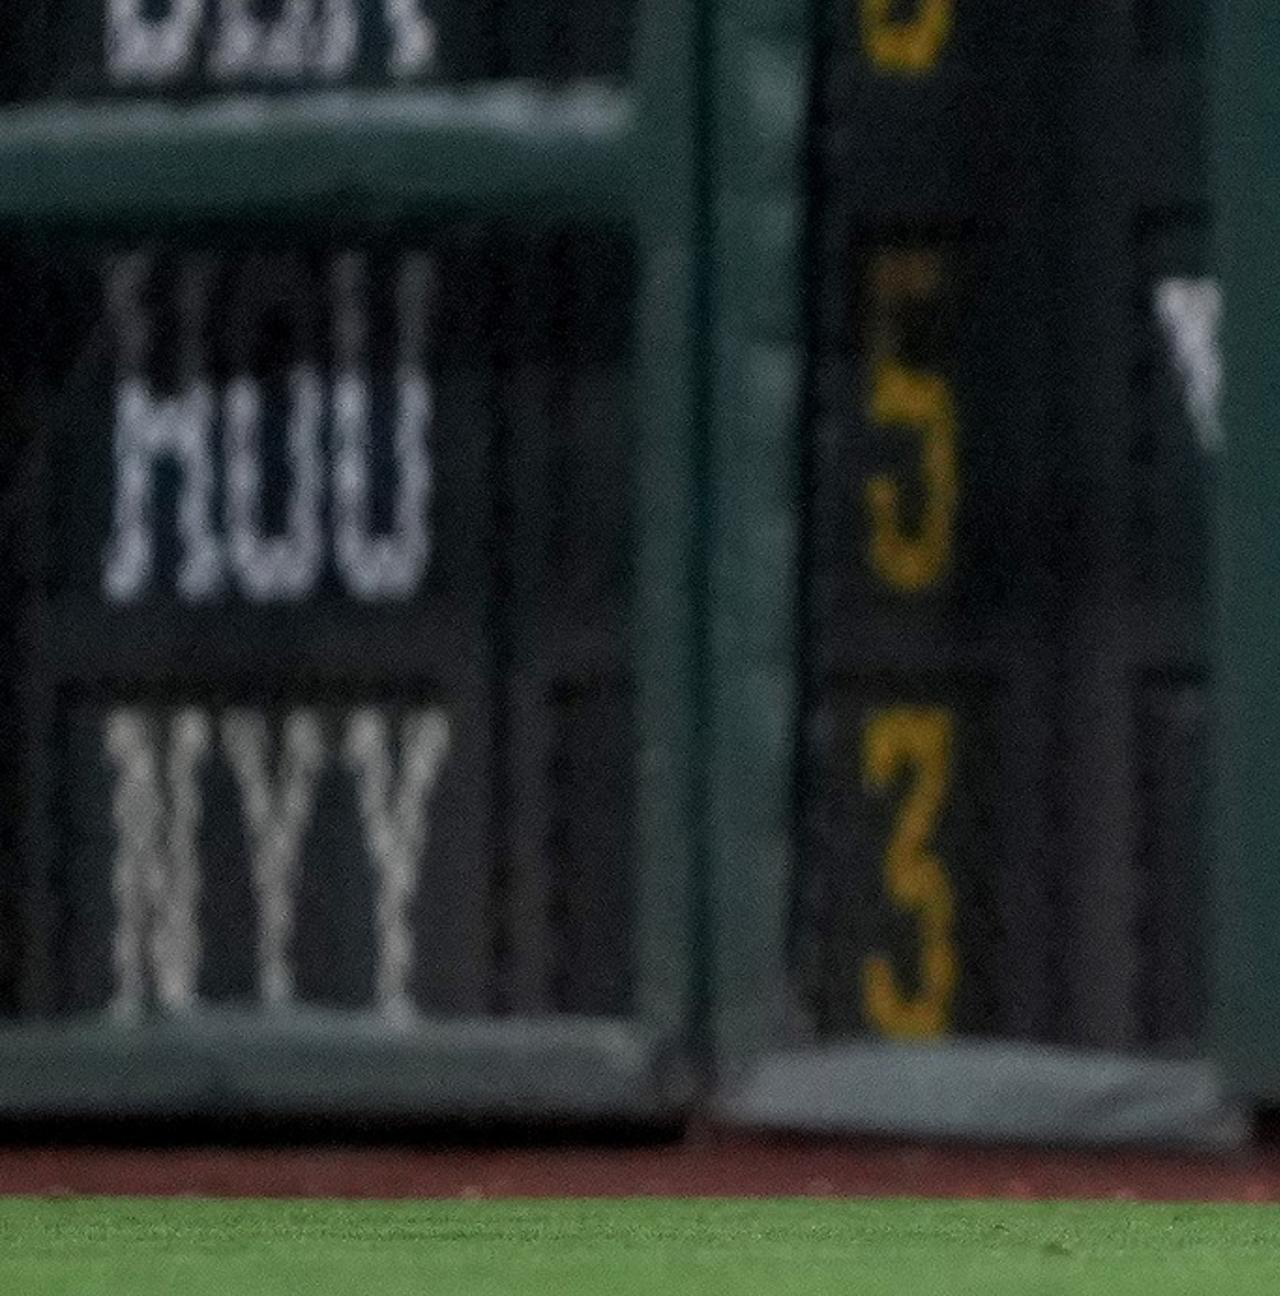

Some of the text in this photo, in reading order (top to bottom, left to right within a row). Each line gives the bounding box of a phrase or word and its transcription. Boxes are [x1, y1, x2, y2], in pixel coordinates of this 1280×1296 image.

[103, 250, 437, 607] HOU
[862, 249, 958, 594] 5
[105, 704, 452, 1029] NYY
[862, 704, 957, 1041] 3
